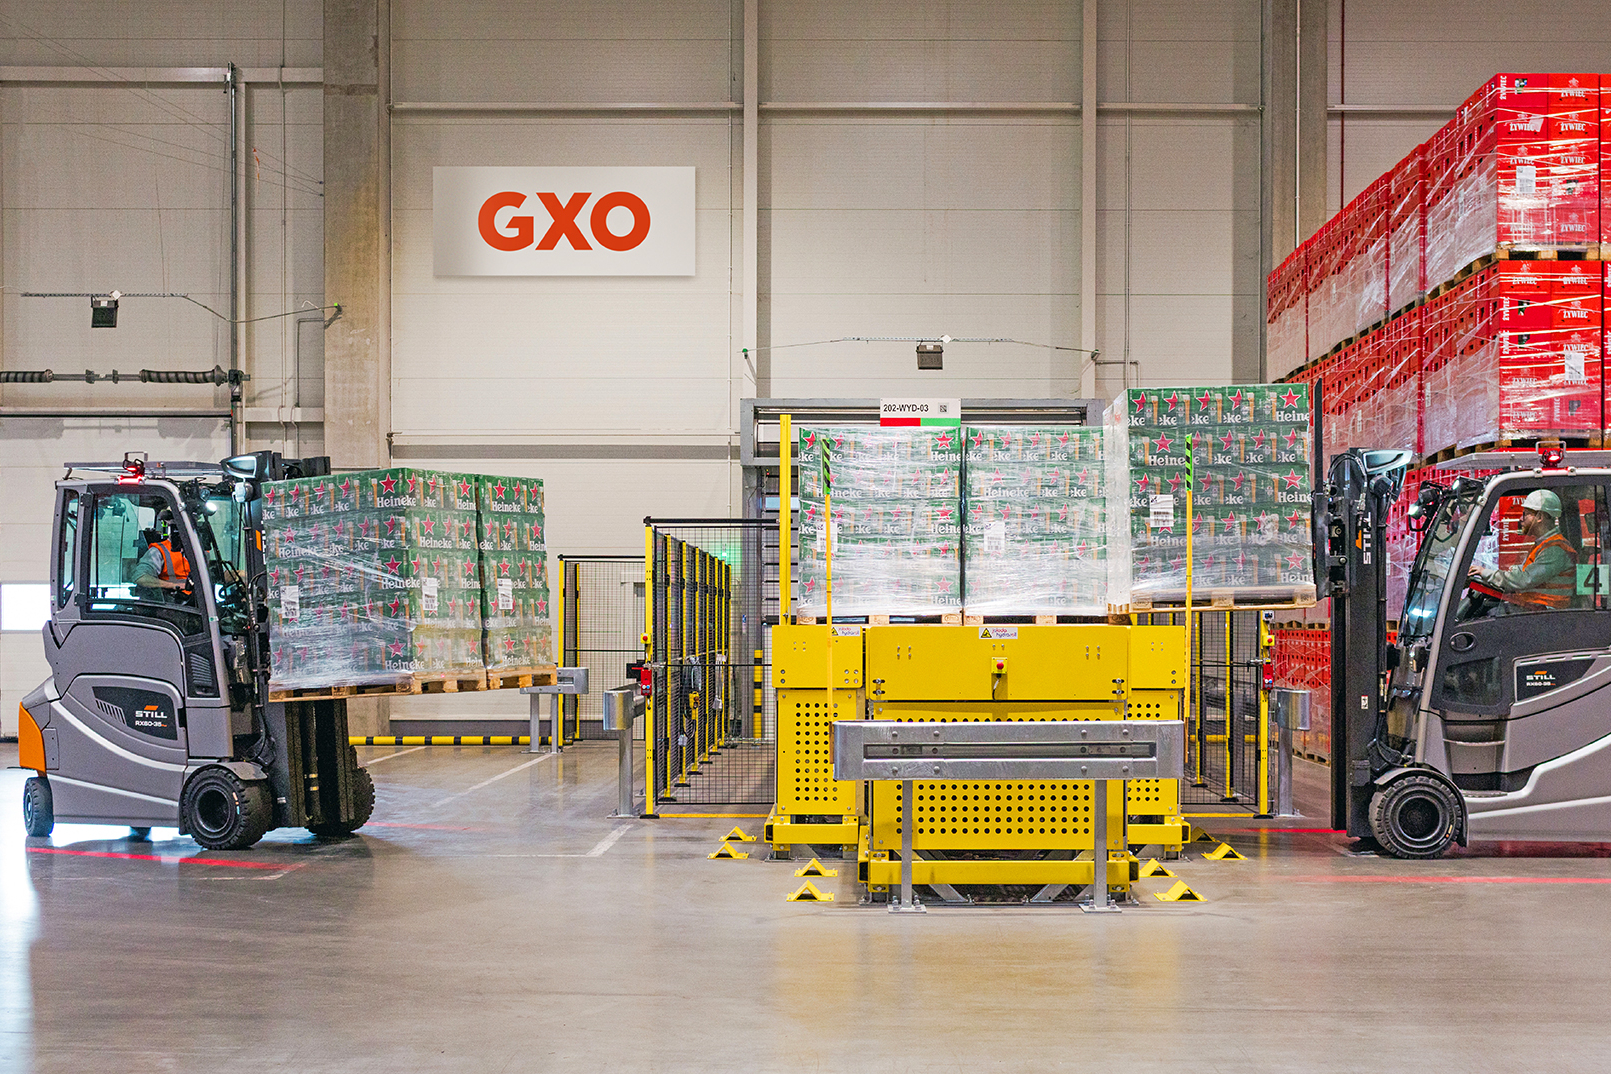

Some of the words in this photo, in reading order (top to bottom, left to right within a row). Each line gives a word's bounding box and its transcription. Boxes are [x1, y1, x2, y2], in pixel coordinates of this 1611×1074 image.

[477, 191, 651, 252] GXO
[883, 404, 929, 412] 202-WYD-03
[376, 495, 416, 508] Heineke
[1584, 568, 1602, 593] 4
[135, 710, 168, 718] STILL
